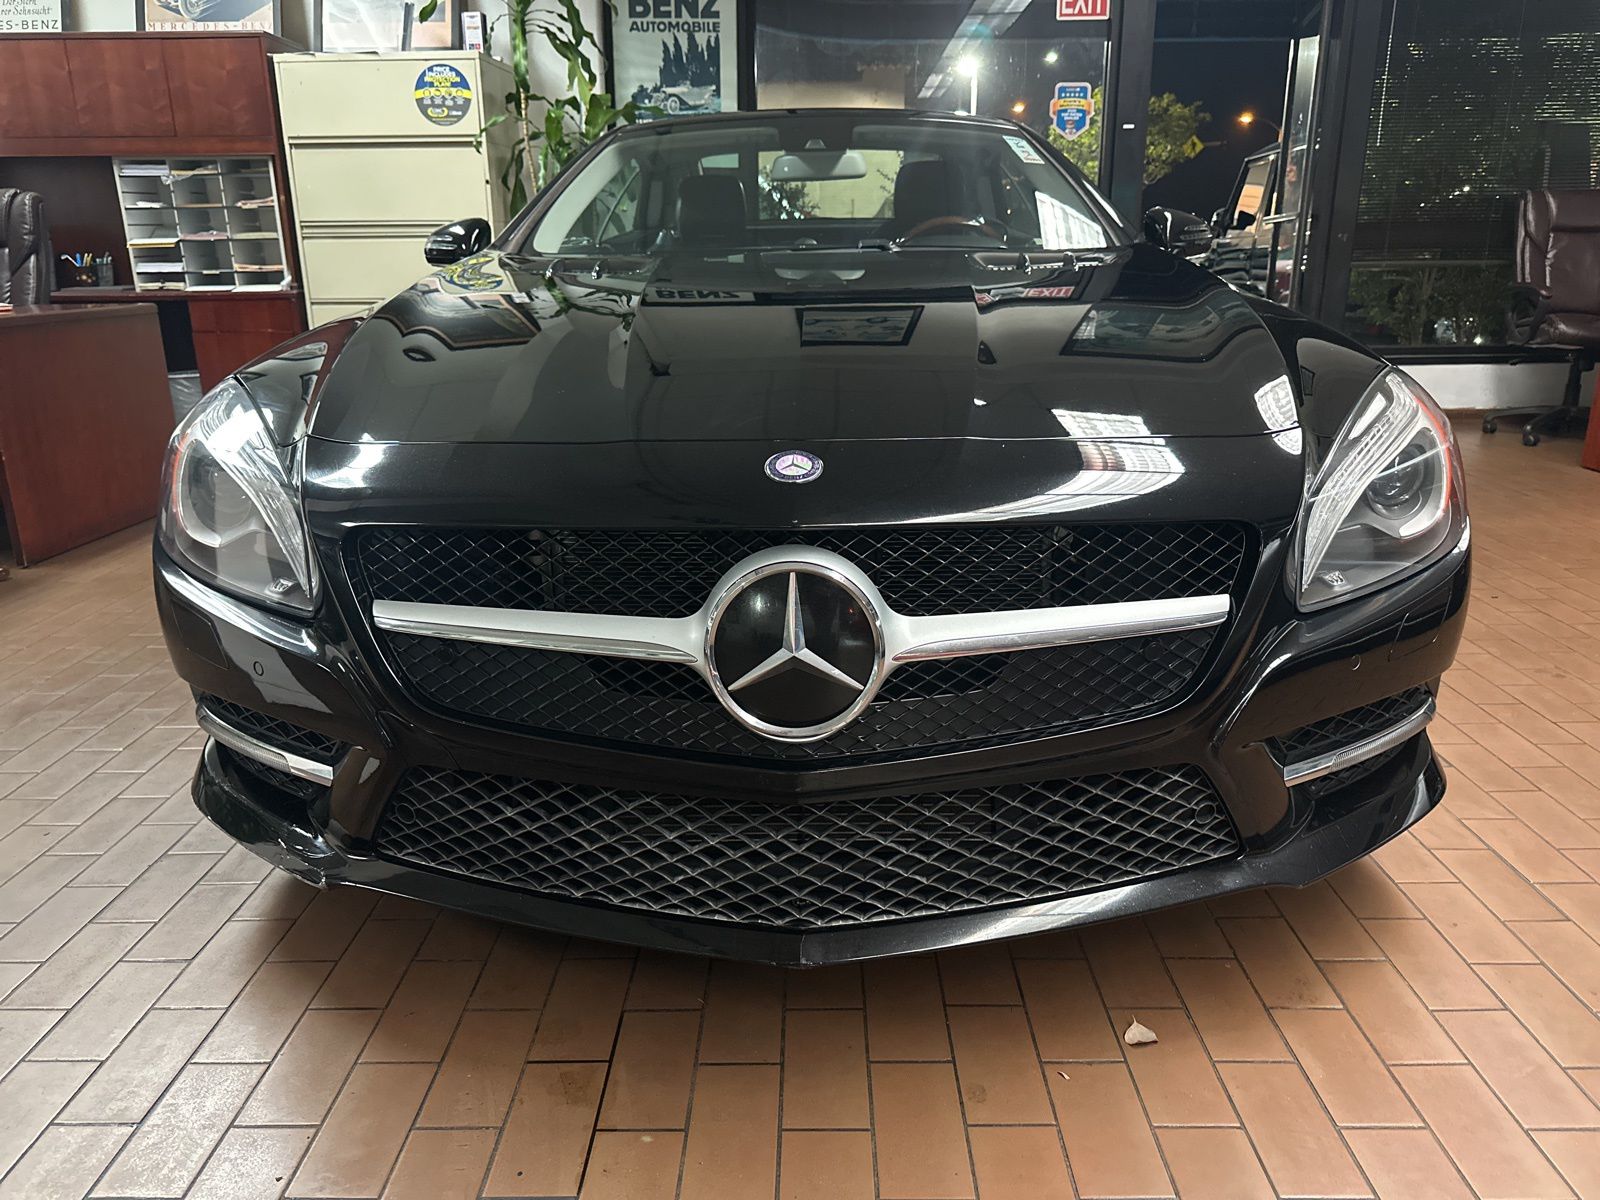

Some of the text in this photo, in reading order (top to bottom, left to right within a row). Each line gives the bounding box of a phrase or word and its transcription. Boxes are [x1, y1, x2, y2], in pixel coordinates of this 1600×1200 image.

[628, 0, 720, 18] BENZ
[148, 22, 273, 31] MERCEDES-BENZ
[629, 21, 720, 32] AUTOMOBILE
